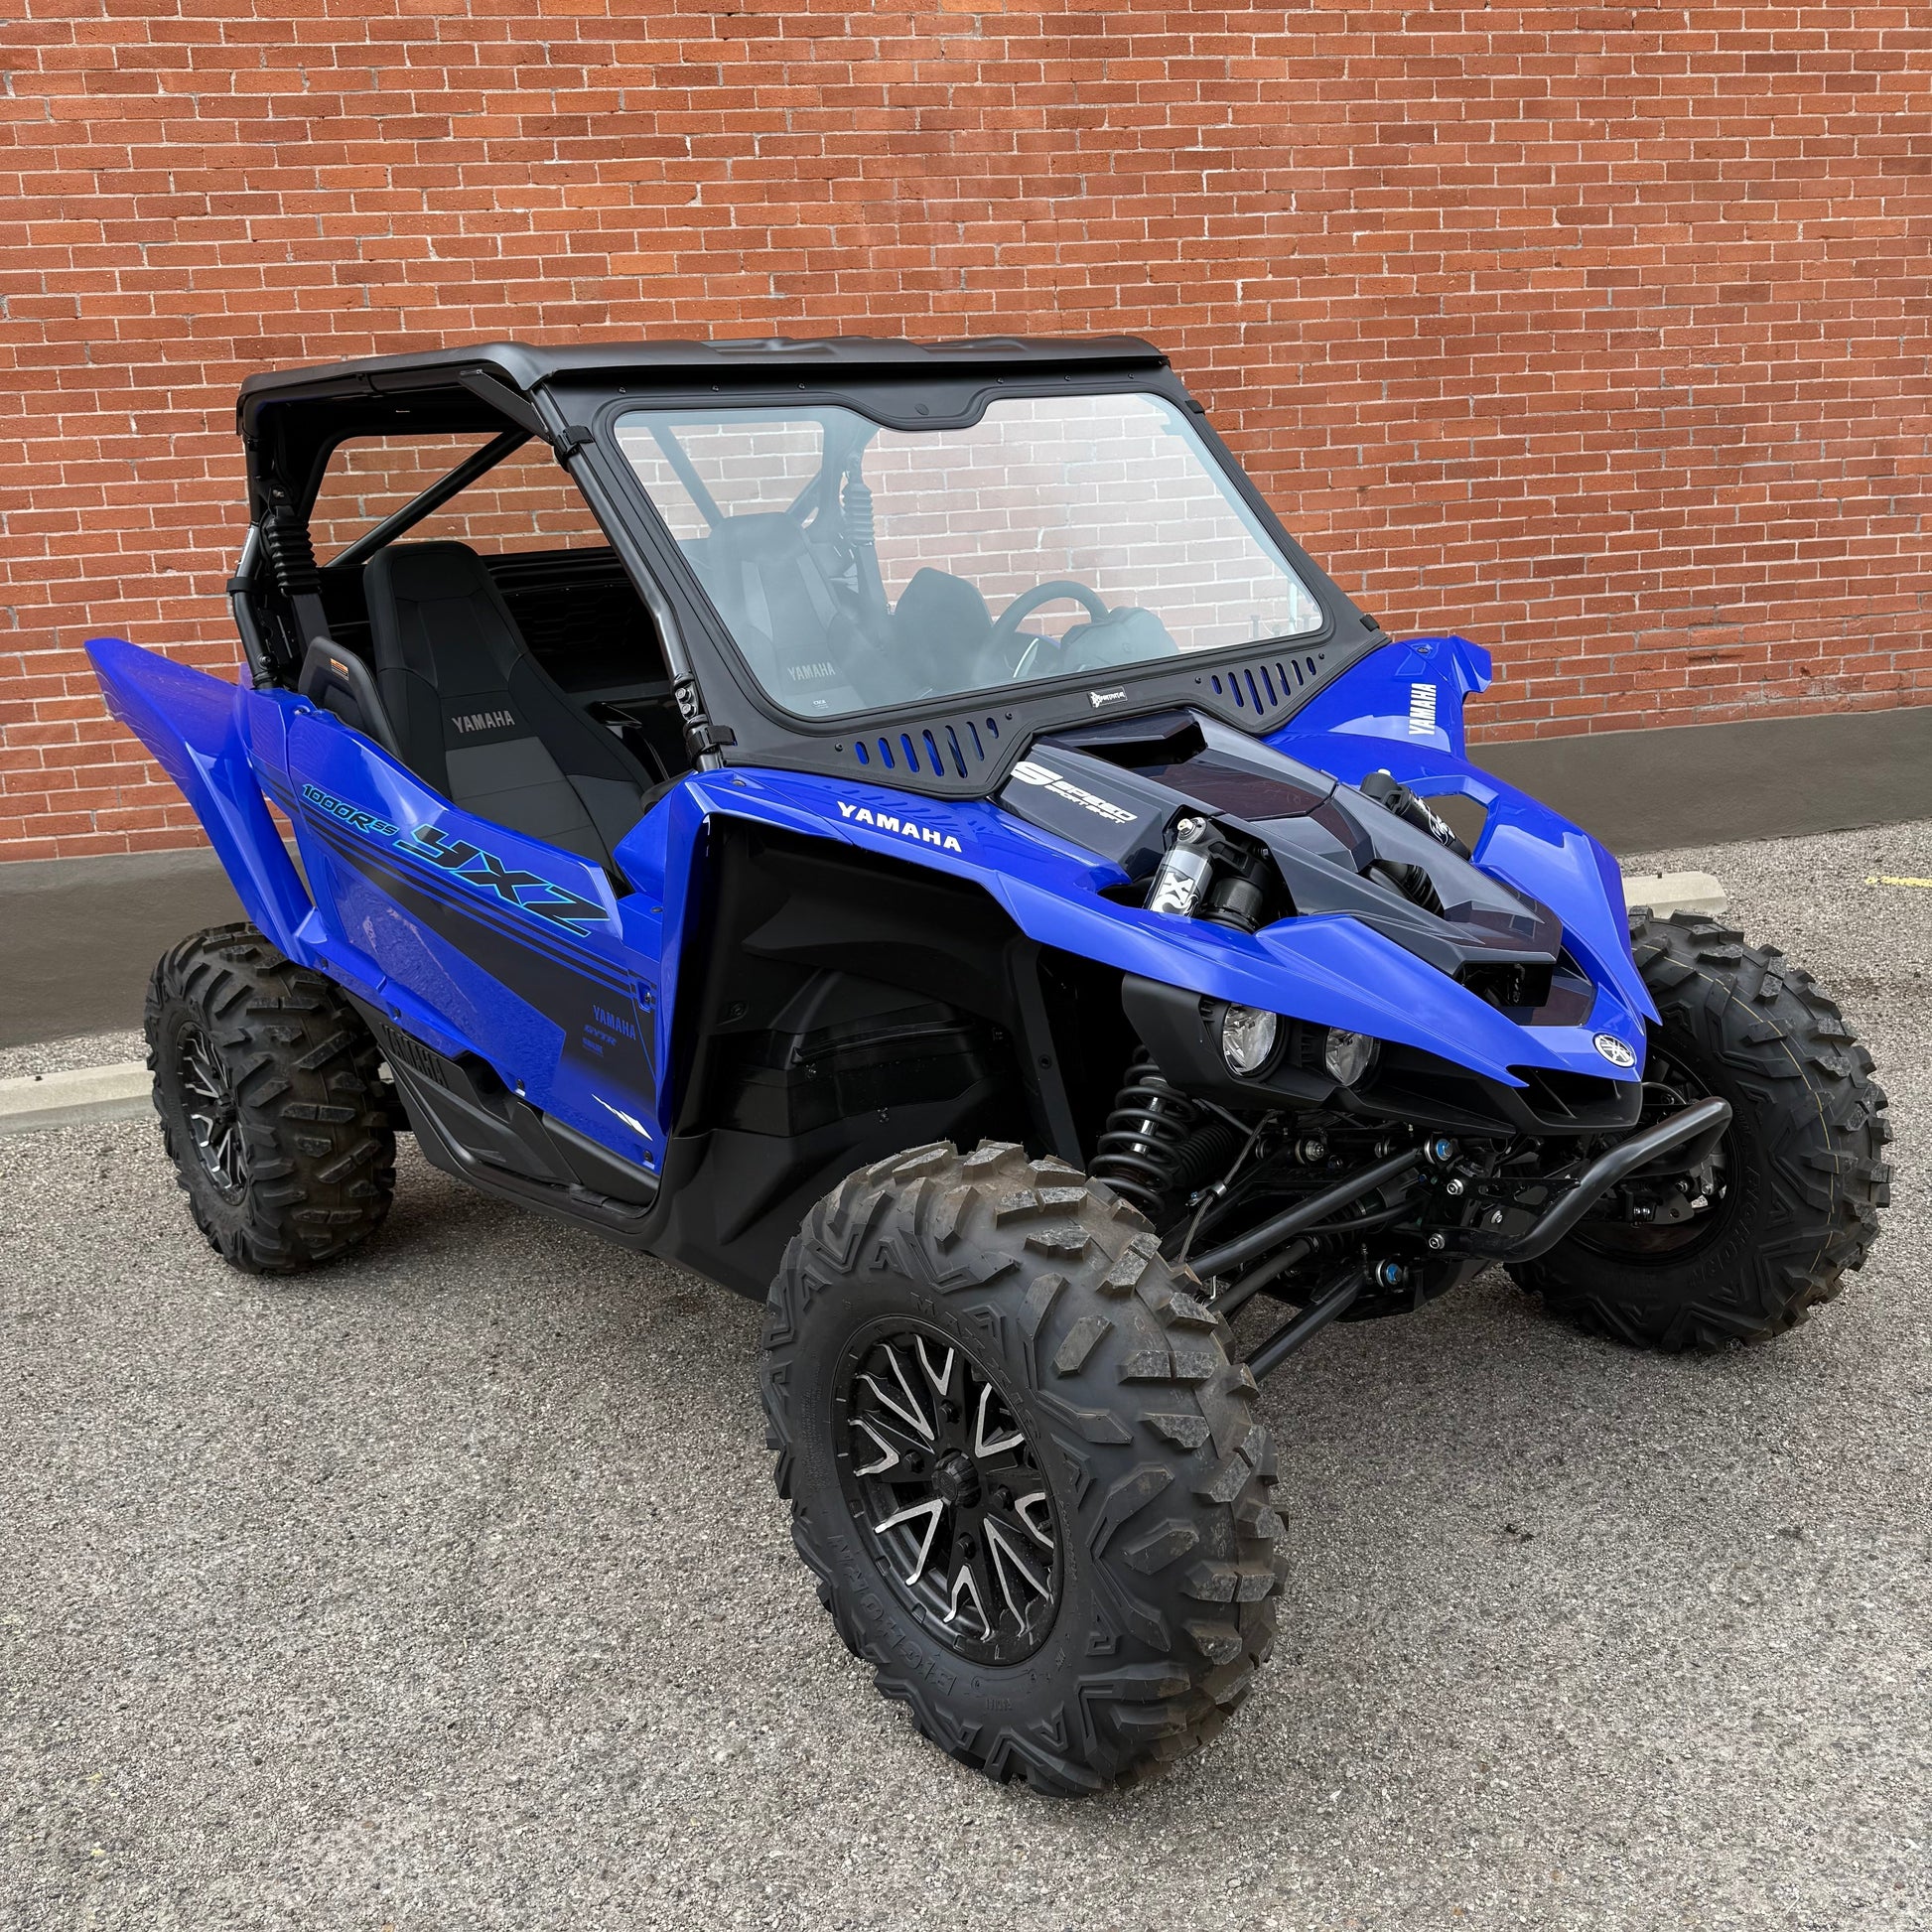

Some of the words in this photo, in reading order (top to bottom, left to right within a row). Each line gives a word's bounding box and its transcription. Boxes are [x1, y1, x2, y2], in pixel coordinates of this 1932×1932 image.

[787, 661, 836, 681] YAMAHA
[451, 710, 515, 734] YAMAHA
[1408, 682, 1437, 735] YAMAHA
[837, 800, 963, 853] YAMAHA
[392, 823, 611, 937] YXZ
[593, 1004, 636, 1040] YAMAHA
[908, 1291, 1042, 1440] MAXXIS
